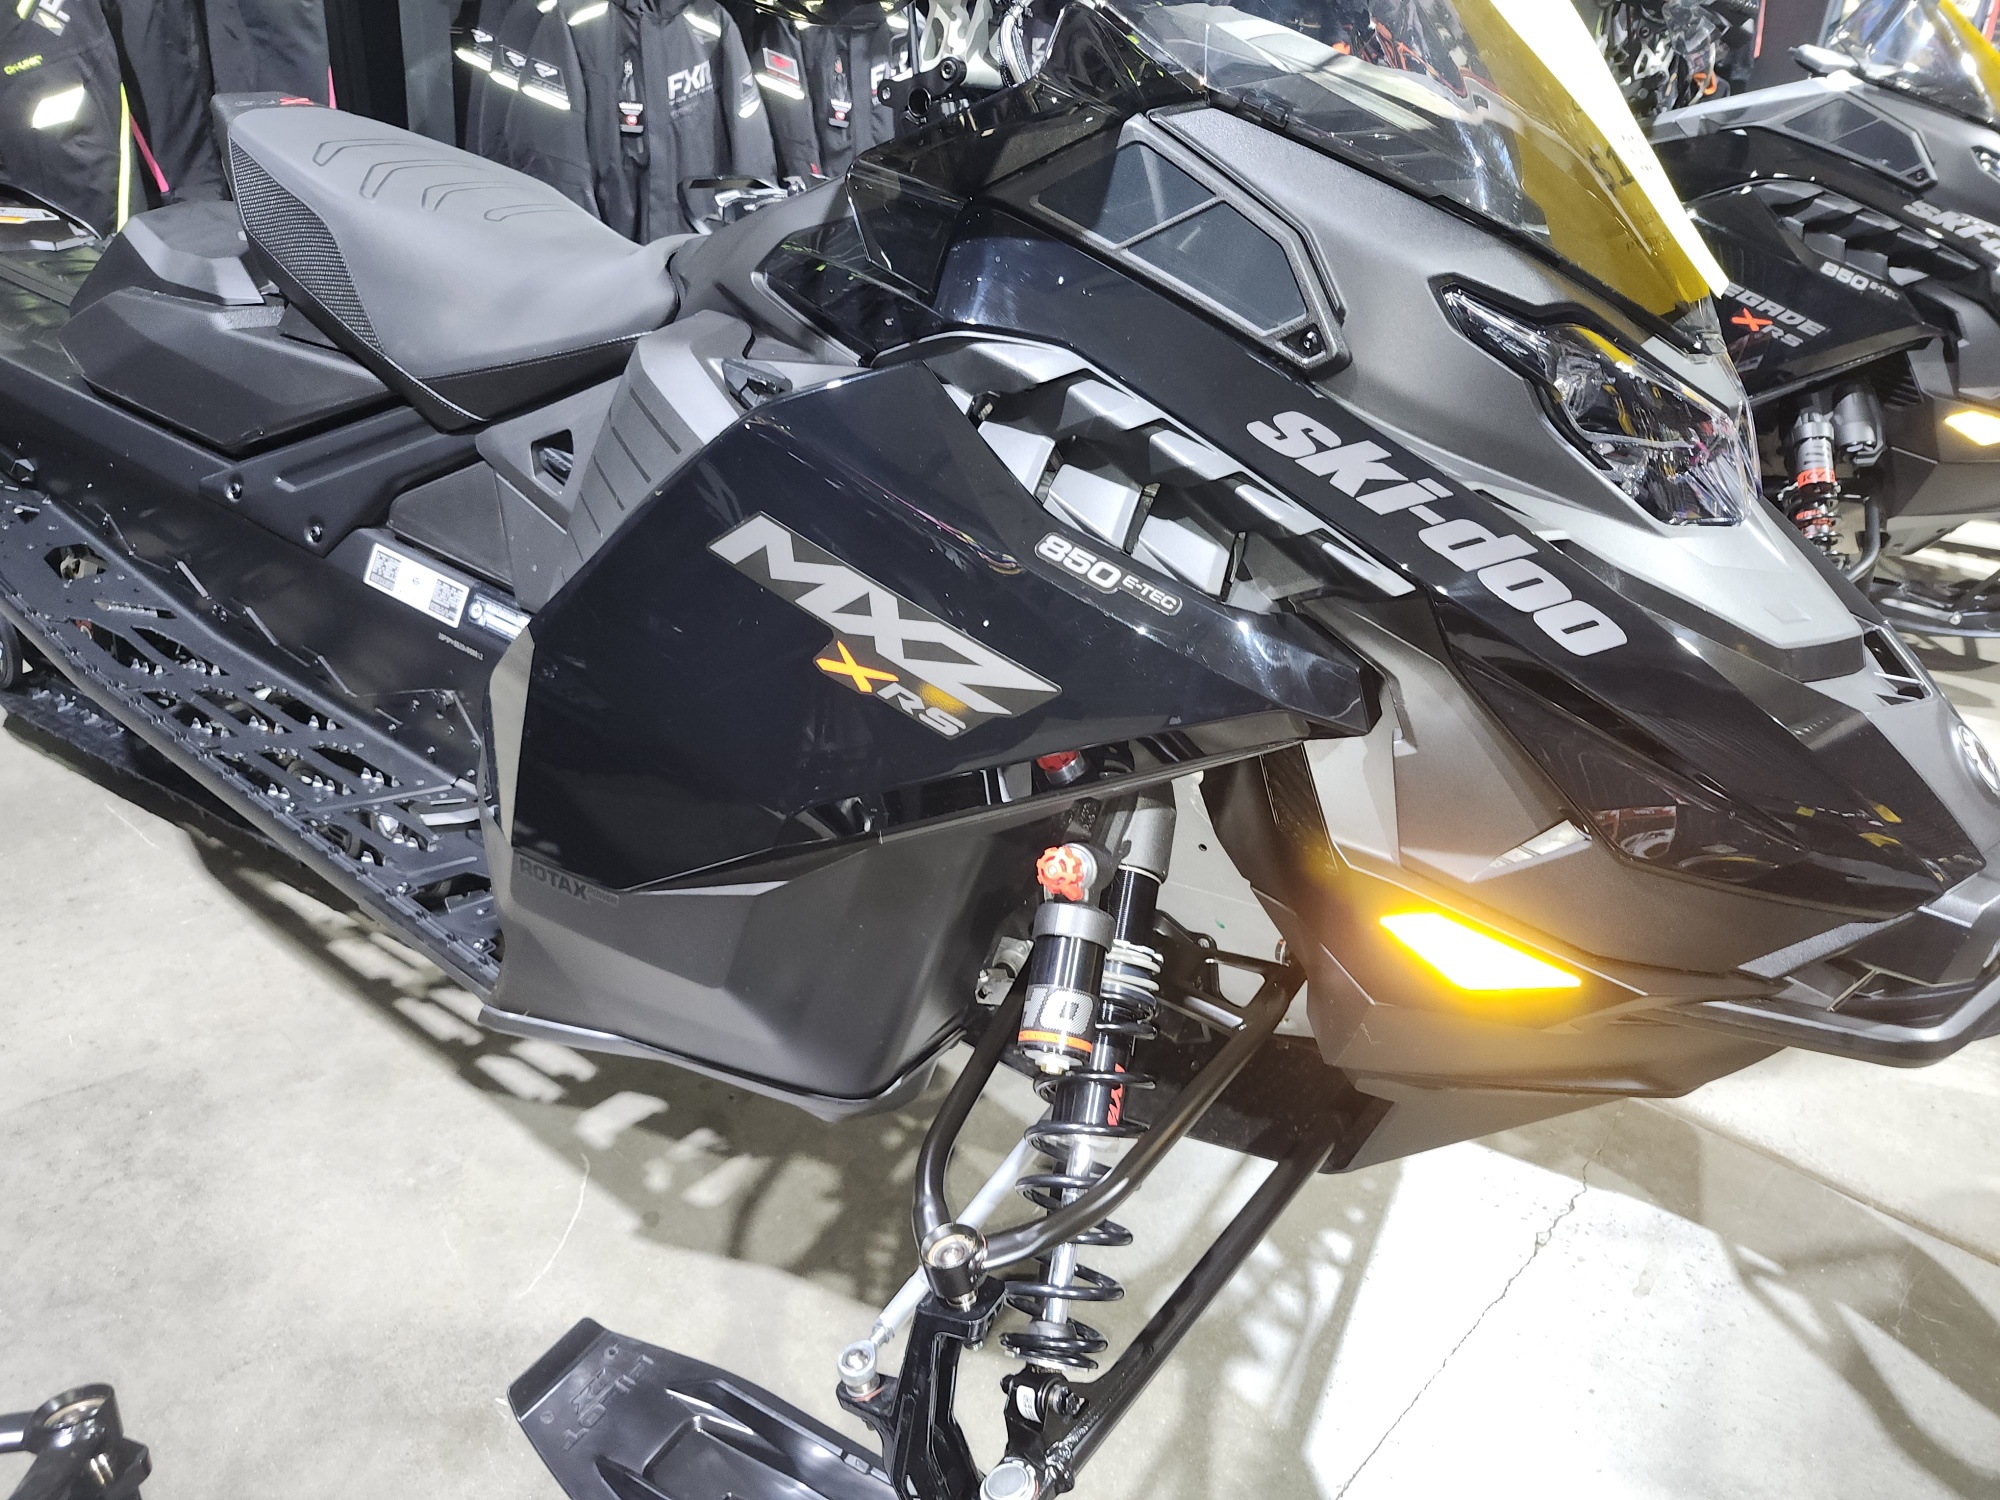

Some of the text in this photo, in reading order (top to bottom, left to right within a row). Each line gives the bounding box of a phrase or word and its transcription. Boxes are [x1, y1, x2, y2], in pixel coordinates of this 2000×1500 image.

[1724, 281, 1827, 337] EGADE
[1820, 261, 1899, 301] 850 E-TEC
[1731, 307, 1804, 348] X RS
[1038, 532, 1179, 612] 850 E-TEC
[709, 514, 1061, 716] MXZ
[814, 639, 967, 738] X RS
[519, 857, 588, 900] ROTAX
